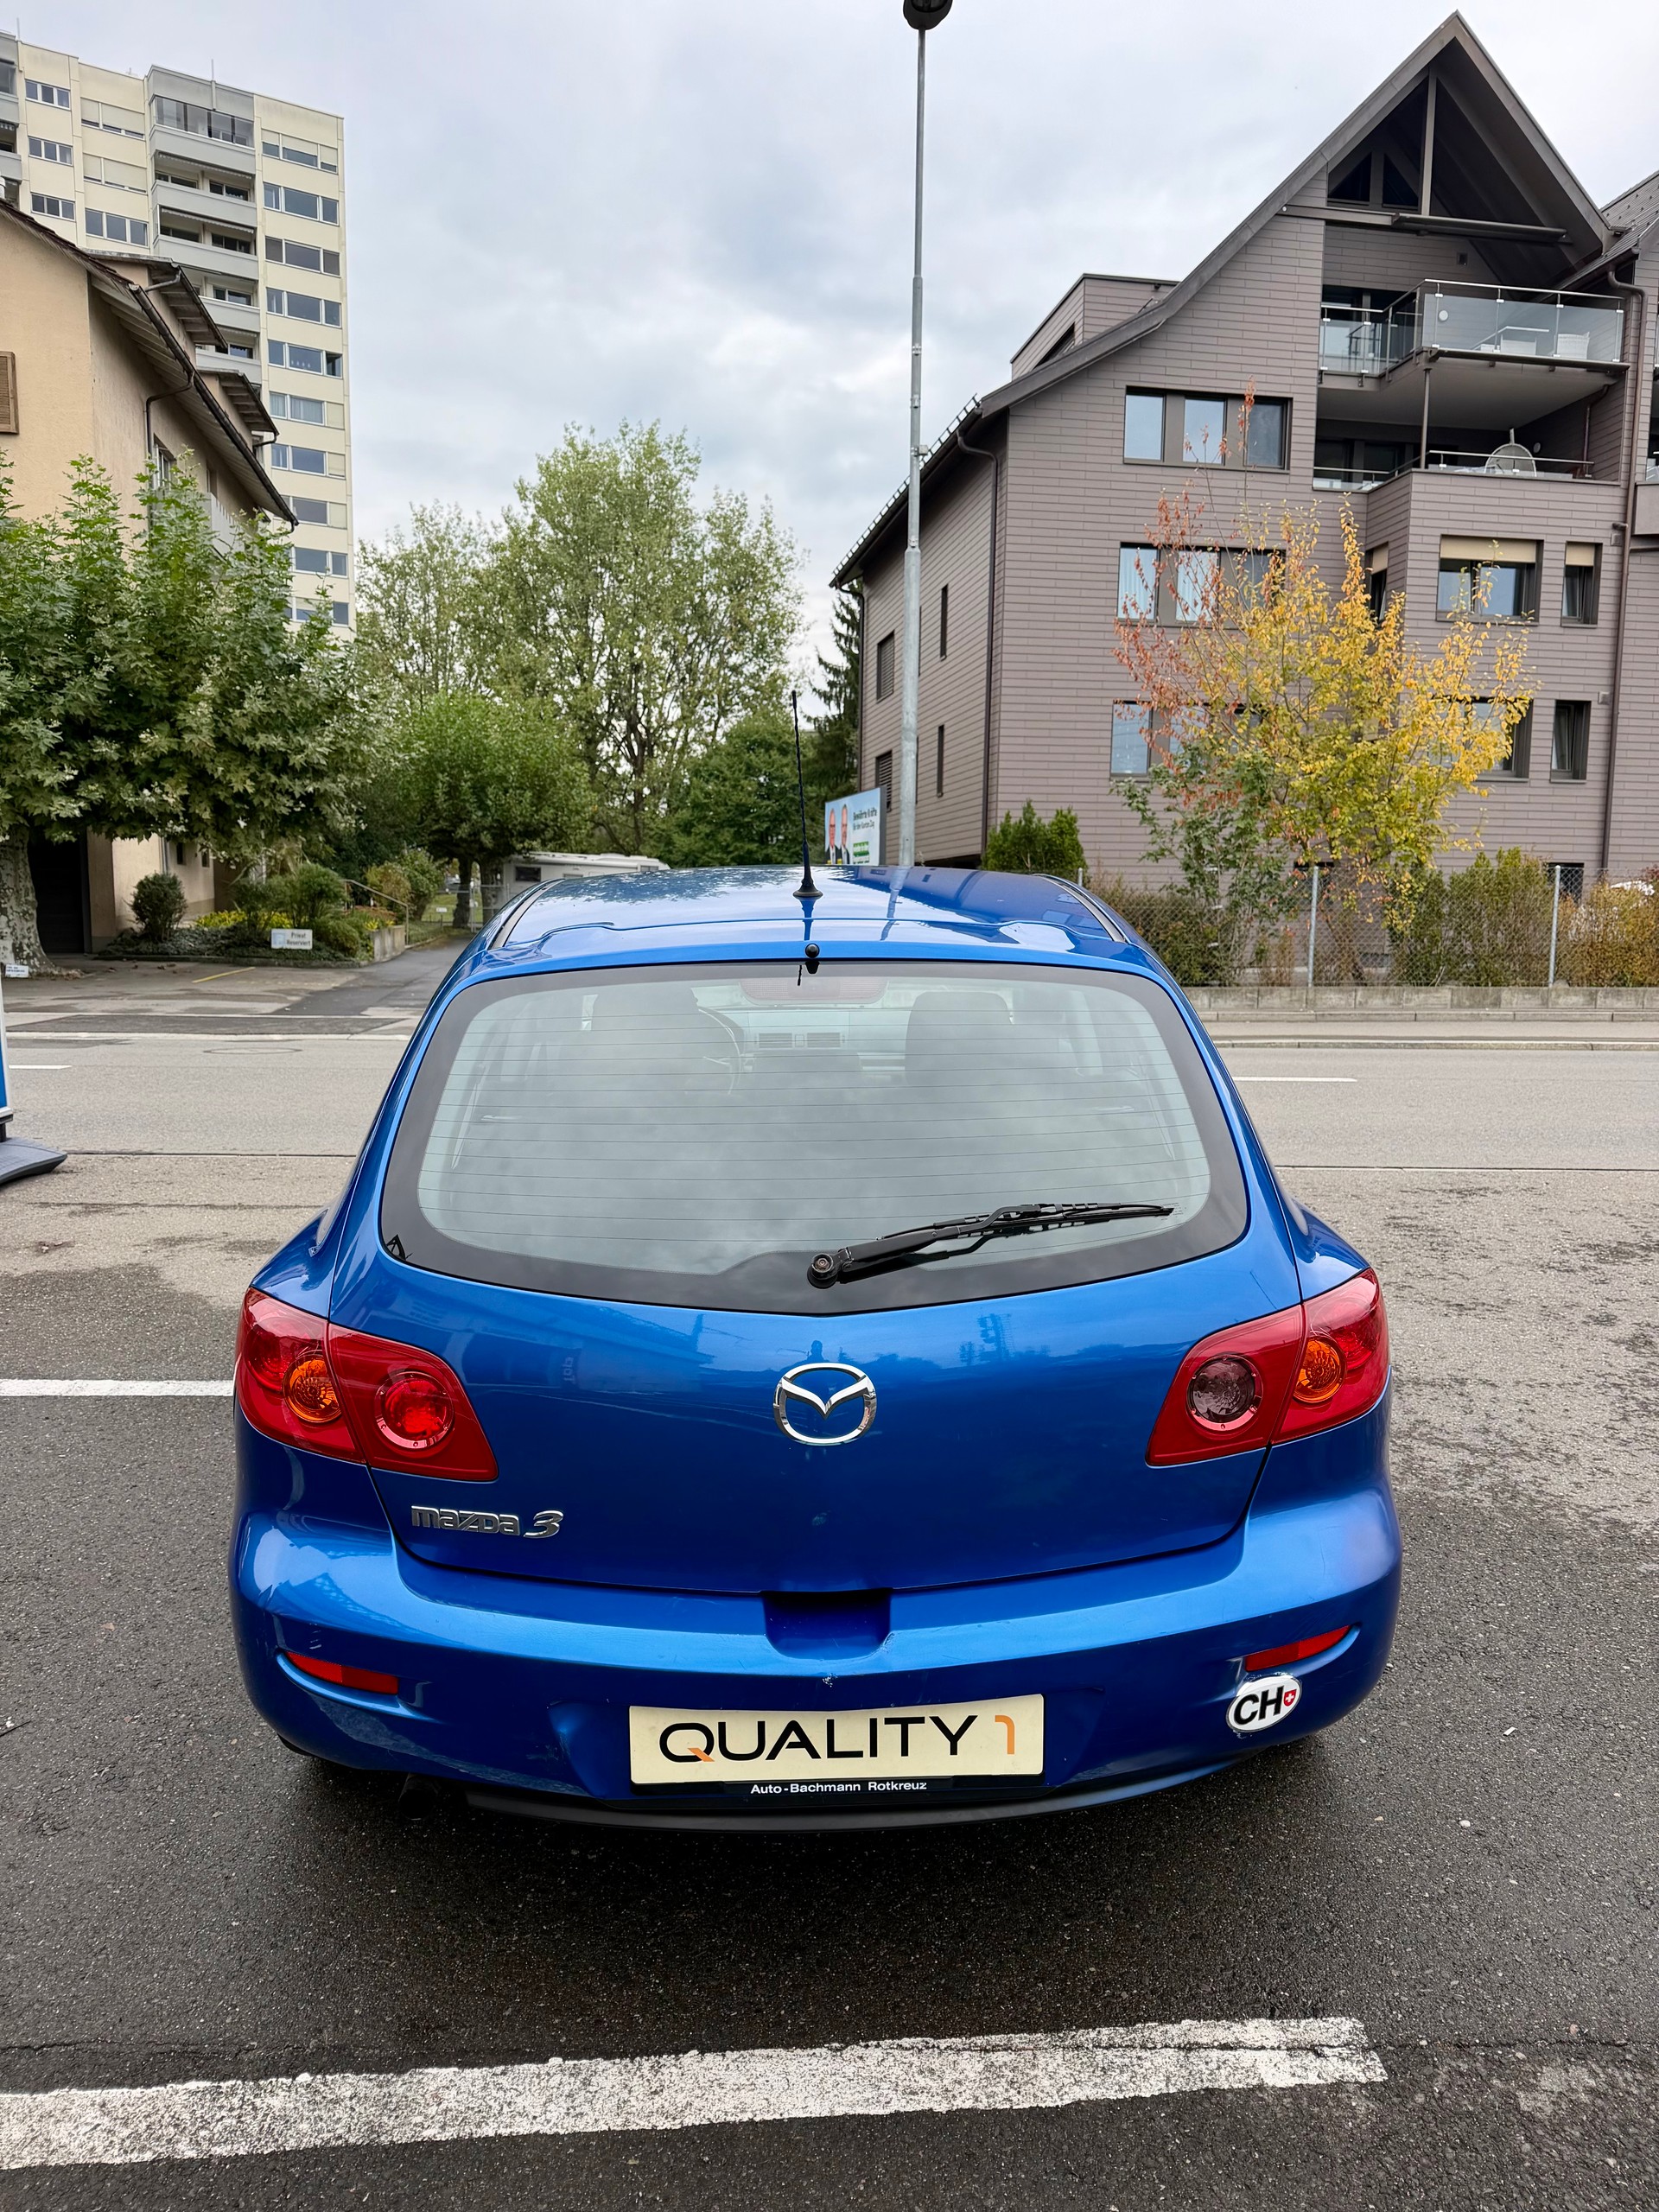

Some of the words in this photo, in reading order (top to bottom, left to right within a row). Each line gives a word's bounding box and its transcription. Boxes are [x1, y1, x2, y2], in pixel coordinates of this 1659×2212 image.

[523, 1510, 564, 1539] 3
[1234, 1685, 1284, 1726] CH
[659, 1715, 979, 1763] QUALITY
[995, 1714, 1015, 1755] 1
[868, 1781, 927, 1791] Rotkreuz
